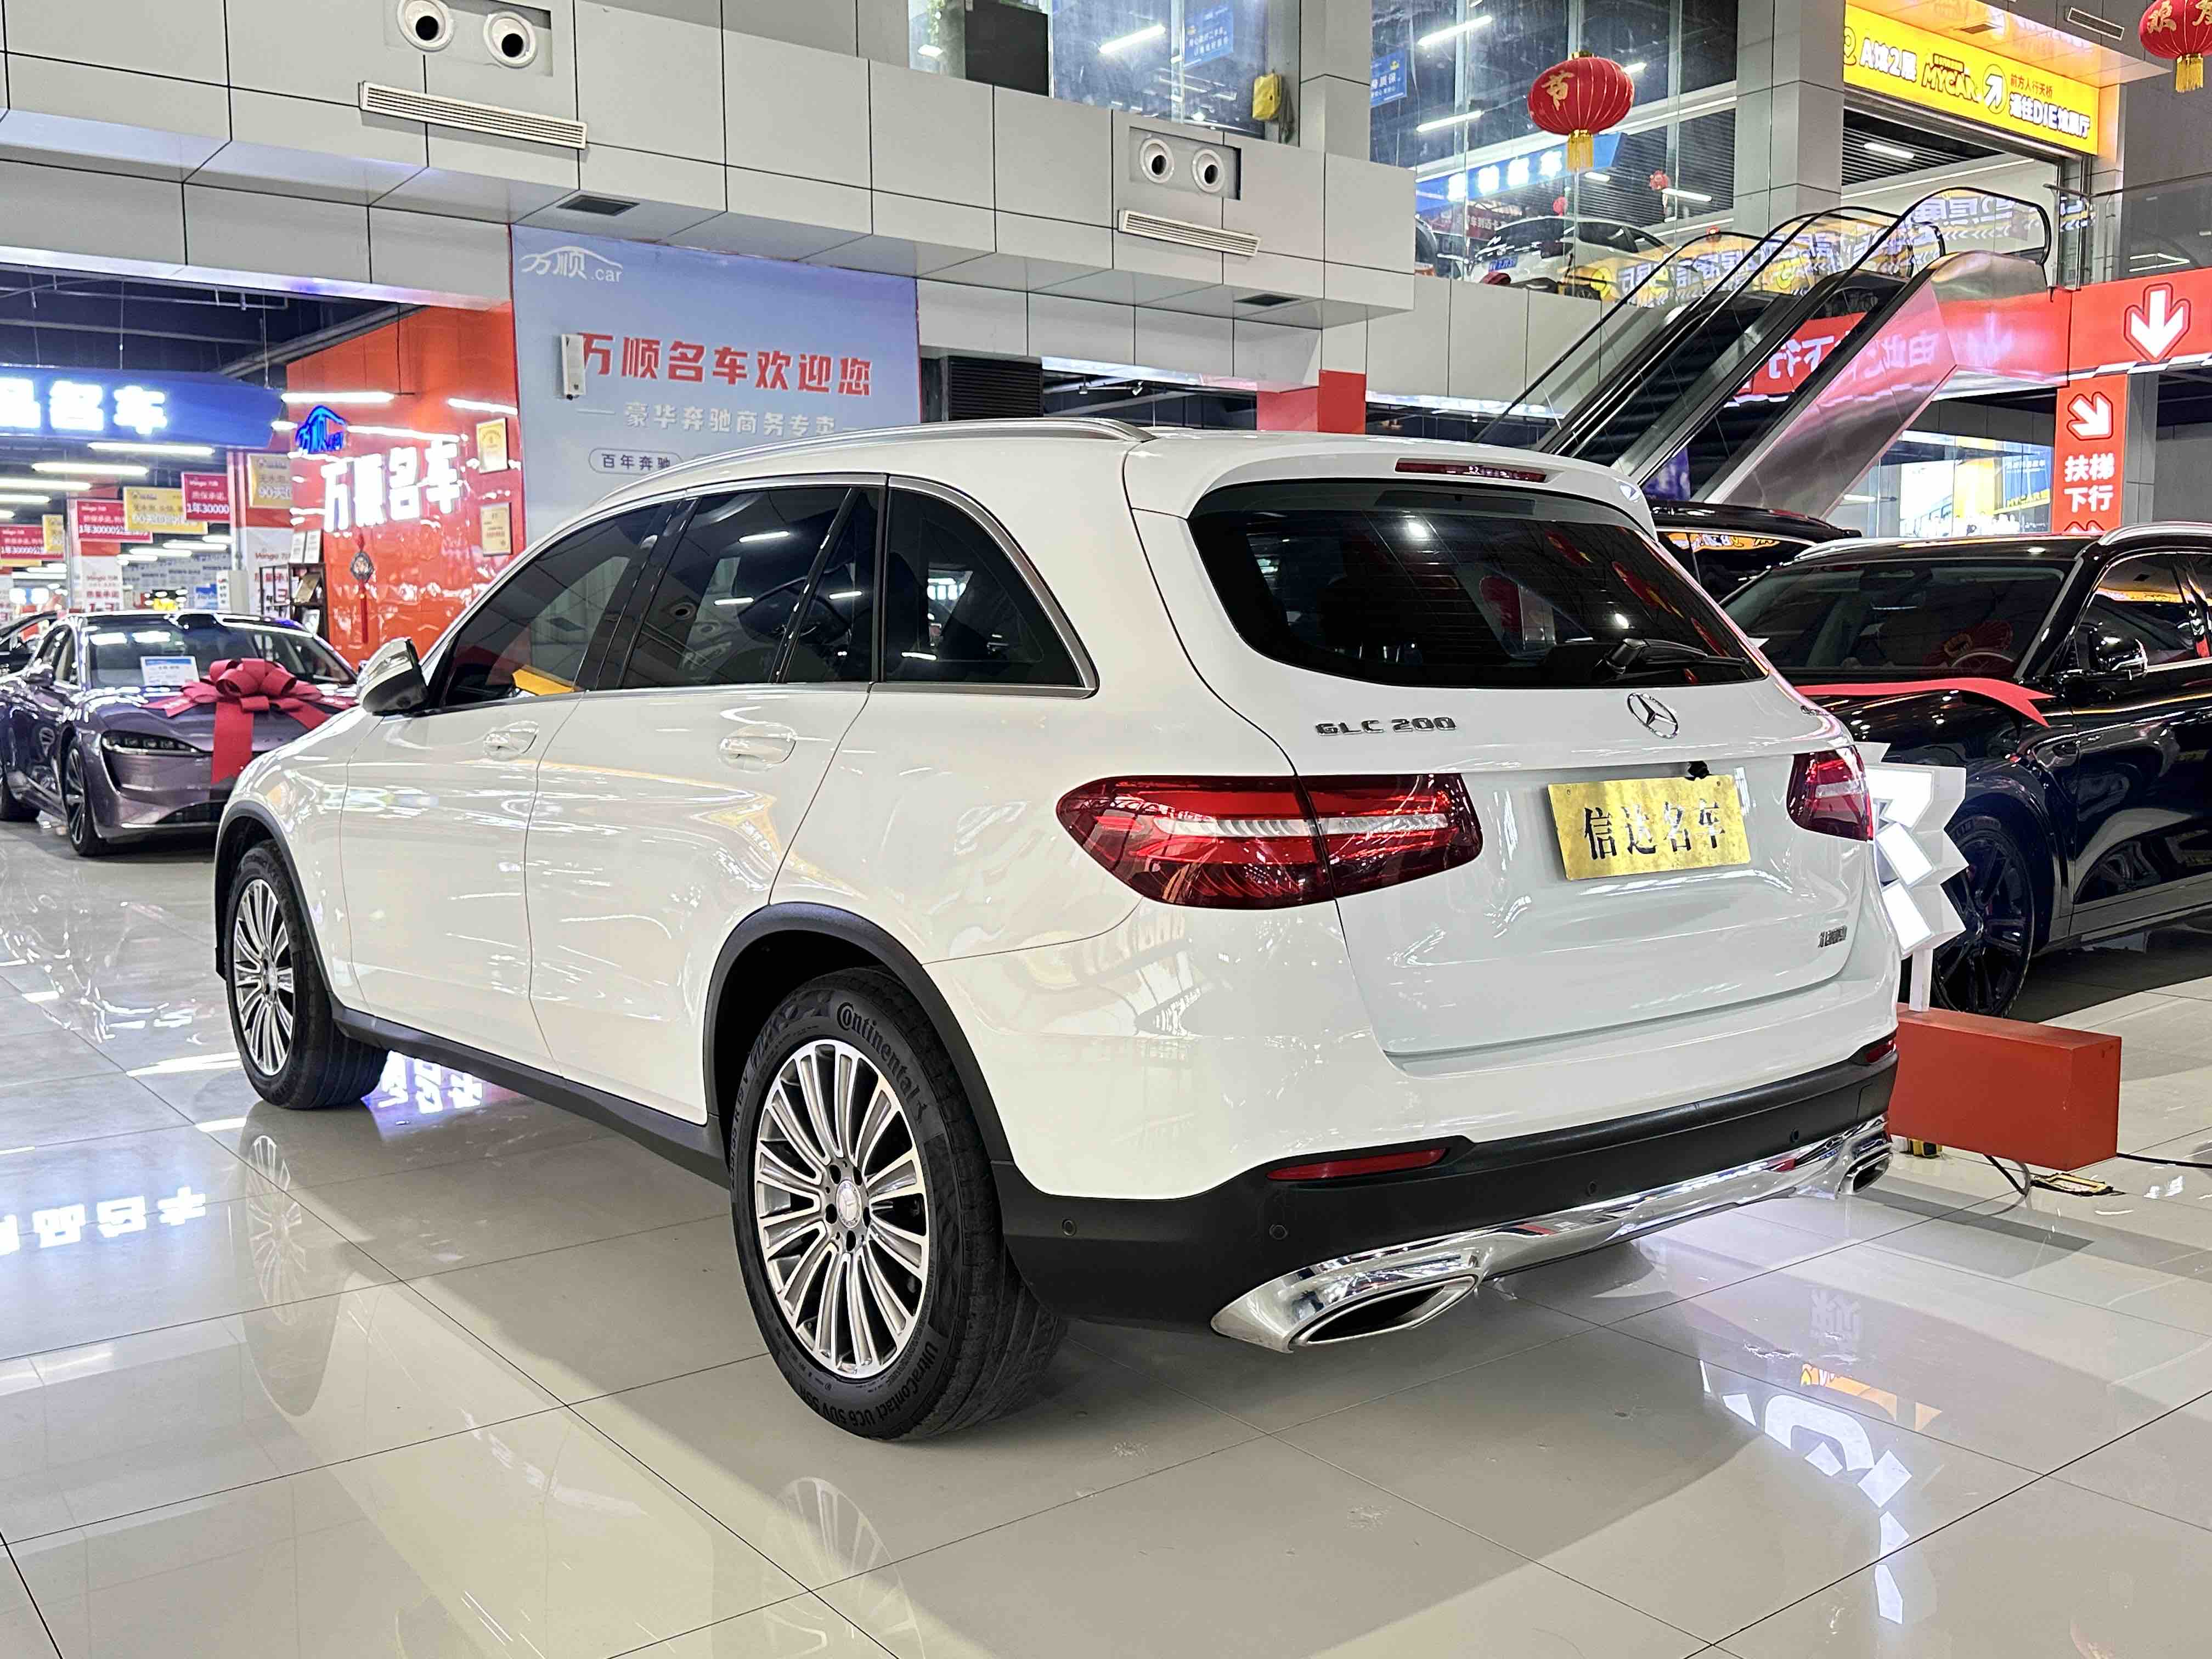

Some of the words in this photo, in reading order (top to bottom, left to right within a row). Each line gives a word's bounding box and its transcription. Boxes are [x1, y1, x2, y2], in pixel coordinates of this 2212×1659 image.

[578, 331, 872, 396] 万顺名车欢迎您
[624, 401, 837, 436] 豪华奔驰商务专卖
[601, 453, 671, 471] 百年奔驰
[2063, 452, 2116, 483] 扶梯
[2063, 484, 2114, 513] 下行
[1316, 720, 1384, 736] GLC
[1391, 716, 1457, 733] 200
[837, 1001, 921, 1104] Continental
[877, 1341, 939, 1420] UltraContact
